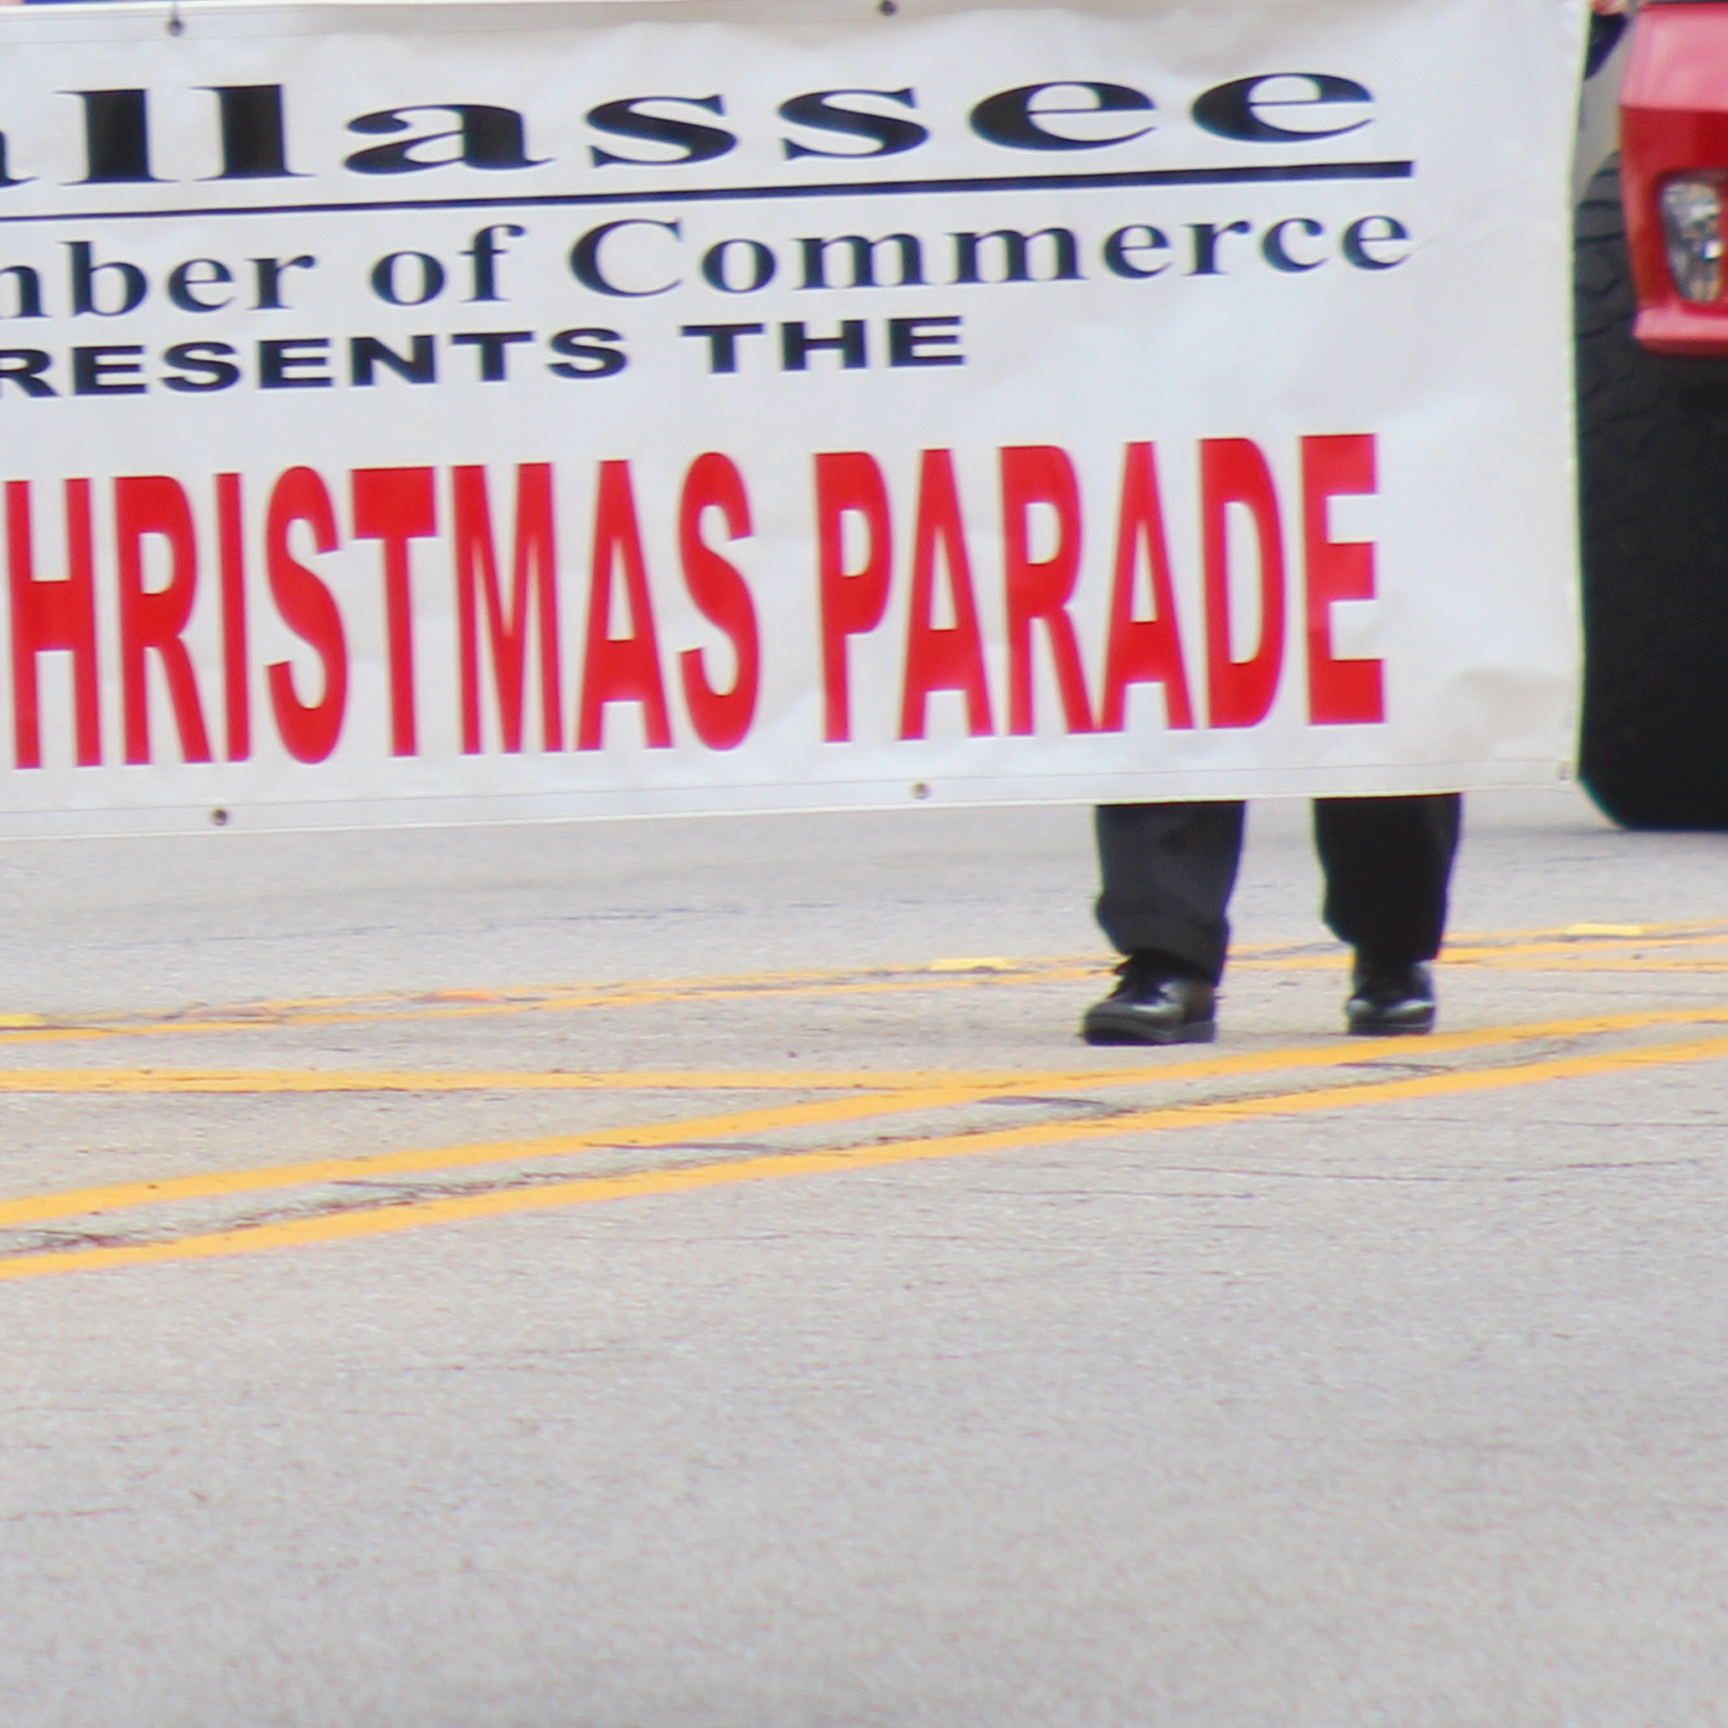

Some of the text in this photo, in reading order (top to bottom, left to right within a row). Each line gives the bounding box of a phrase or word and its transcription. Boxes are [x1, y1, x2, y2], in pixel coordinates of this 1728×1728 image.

[370, 224, 525, 306] of
[569, 215, 1408, 297] Commerce
[681, 315, 964, 374] THE
[814, 433, 1387, 743] PARADE
